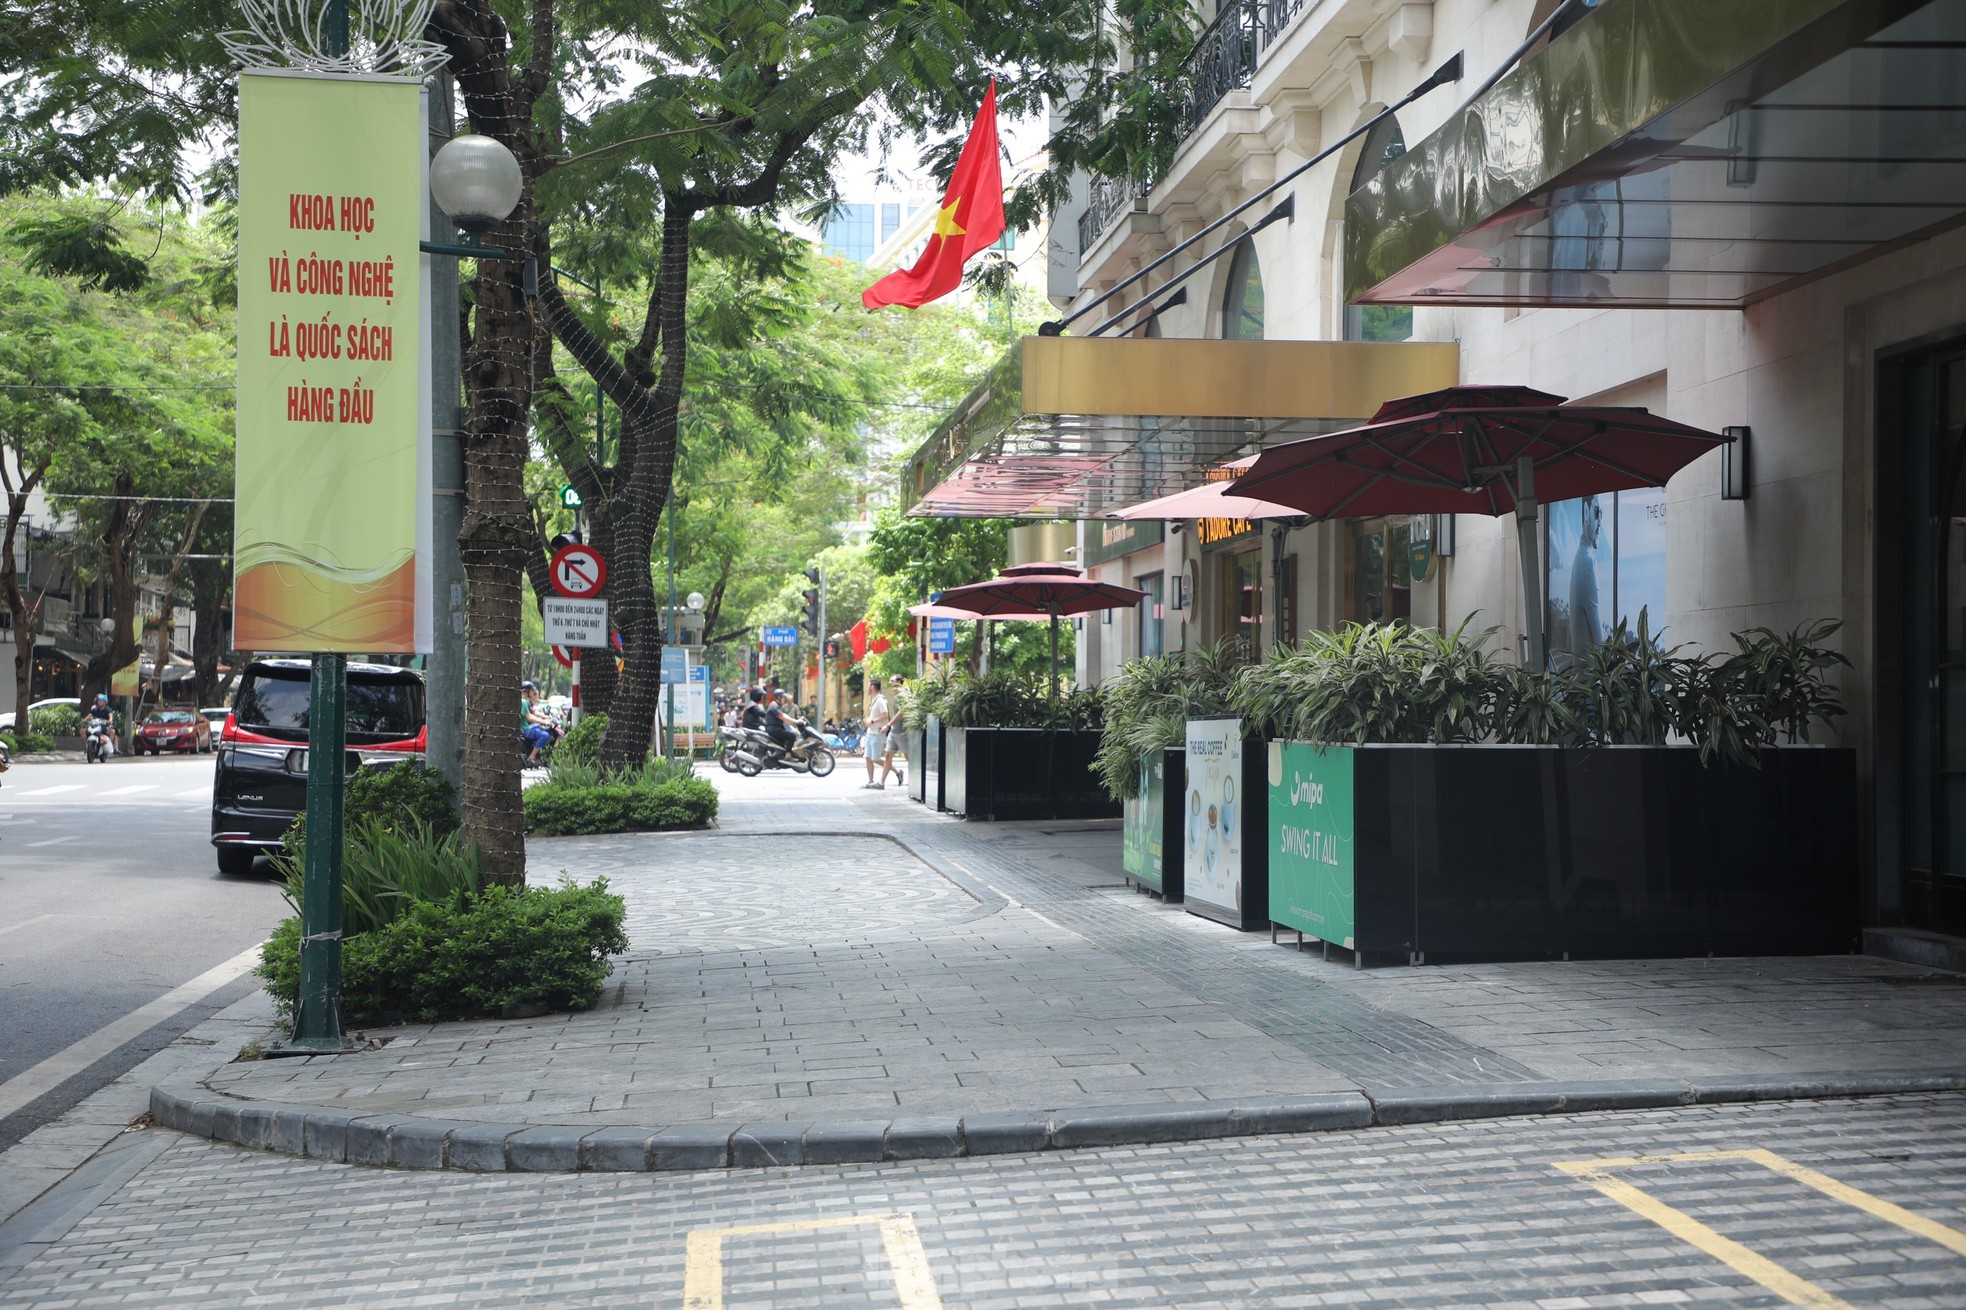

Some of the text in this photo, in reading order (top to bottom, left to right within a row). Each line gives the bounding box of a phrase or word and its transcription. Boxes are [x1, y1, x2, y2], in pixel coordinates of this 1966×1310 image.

[290, 193, 375, 240] KHOA HỌC
[269, 250, 394, 305] VÀ CÔNG NGHỆ
[270, 311, 393, 362] LÀ QUỐC SÁCH
[287, 376, 374, 424] HÀNG ĐẦU
[1646, 503, 1659, 520] THE
[1190, 740, 1198, 755] THE
[1198, 740, 1208, 755] REAL
[1207, 740, 1223, 755] COFFEE
[1300, 772, 1323, 810] mipa
[1281, 824, 1338, 866] SWING IT ALL
